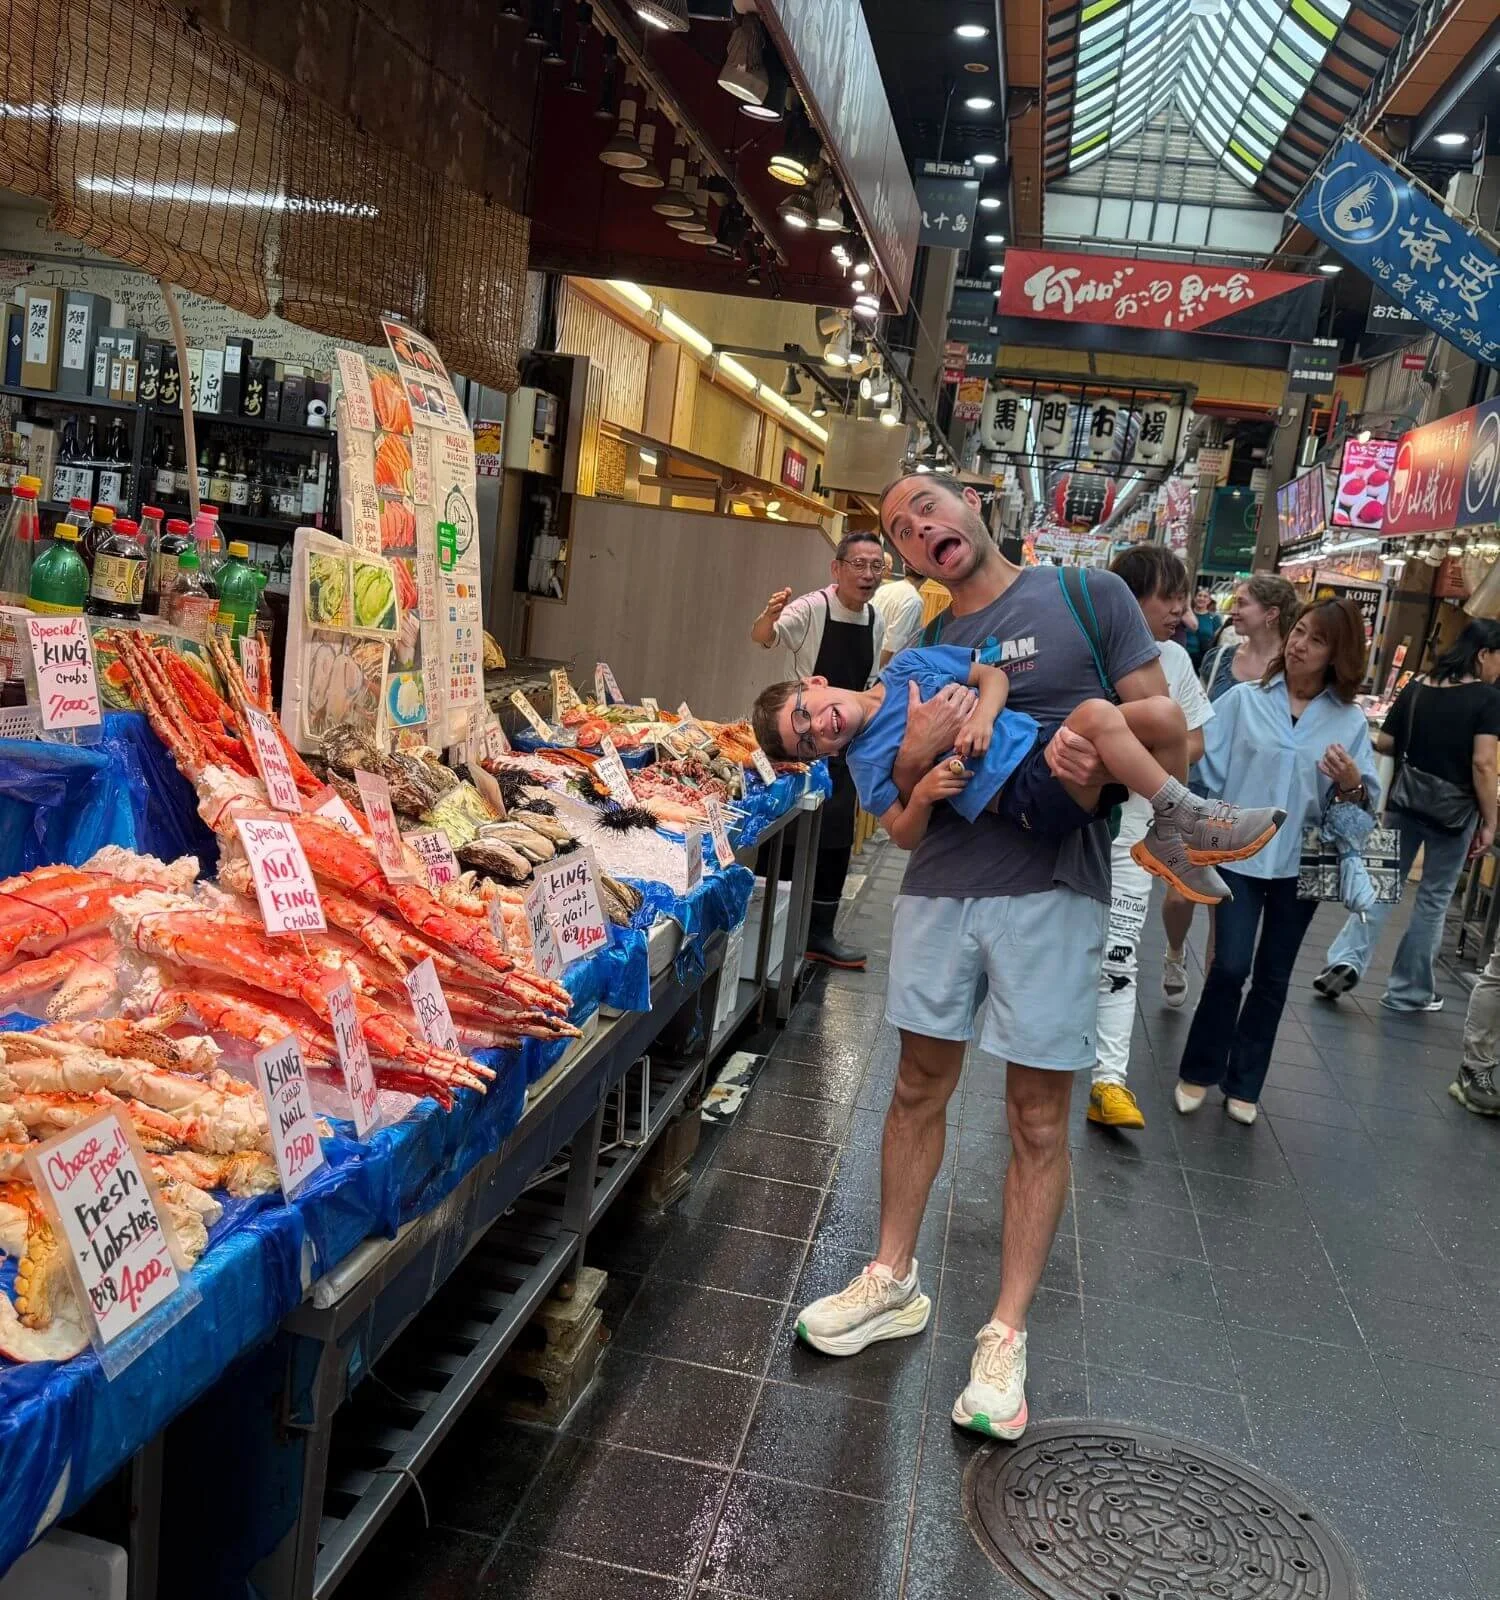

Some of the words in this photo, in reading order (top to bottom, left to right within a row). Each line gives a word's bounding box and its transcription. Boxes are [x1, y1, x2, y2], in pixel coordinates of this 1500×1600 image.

[1372, 304, 1420, 321] おた福
[203, 373, 219, 411] 白州
[992, 397, 1169, 447] 黒門市場
[1345, 589, 1379, 603] KOBE
[43, 639, 87, 667] KING
[551, 863, 587, 894] KING
[270, 888, 317, 912] KING
[264, 1047, 303, 1096] KING
[74, 1167, 138, 1237] Fresh
